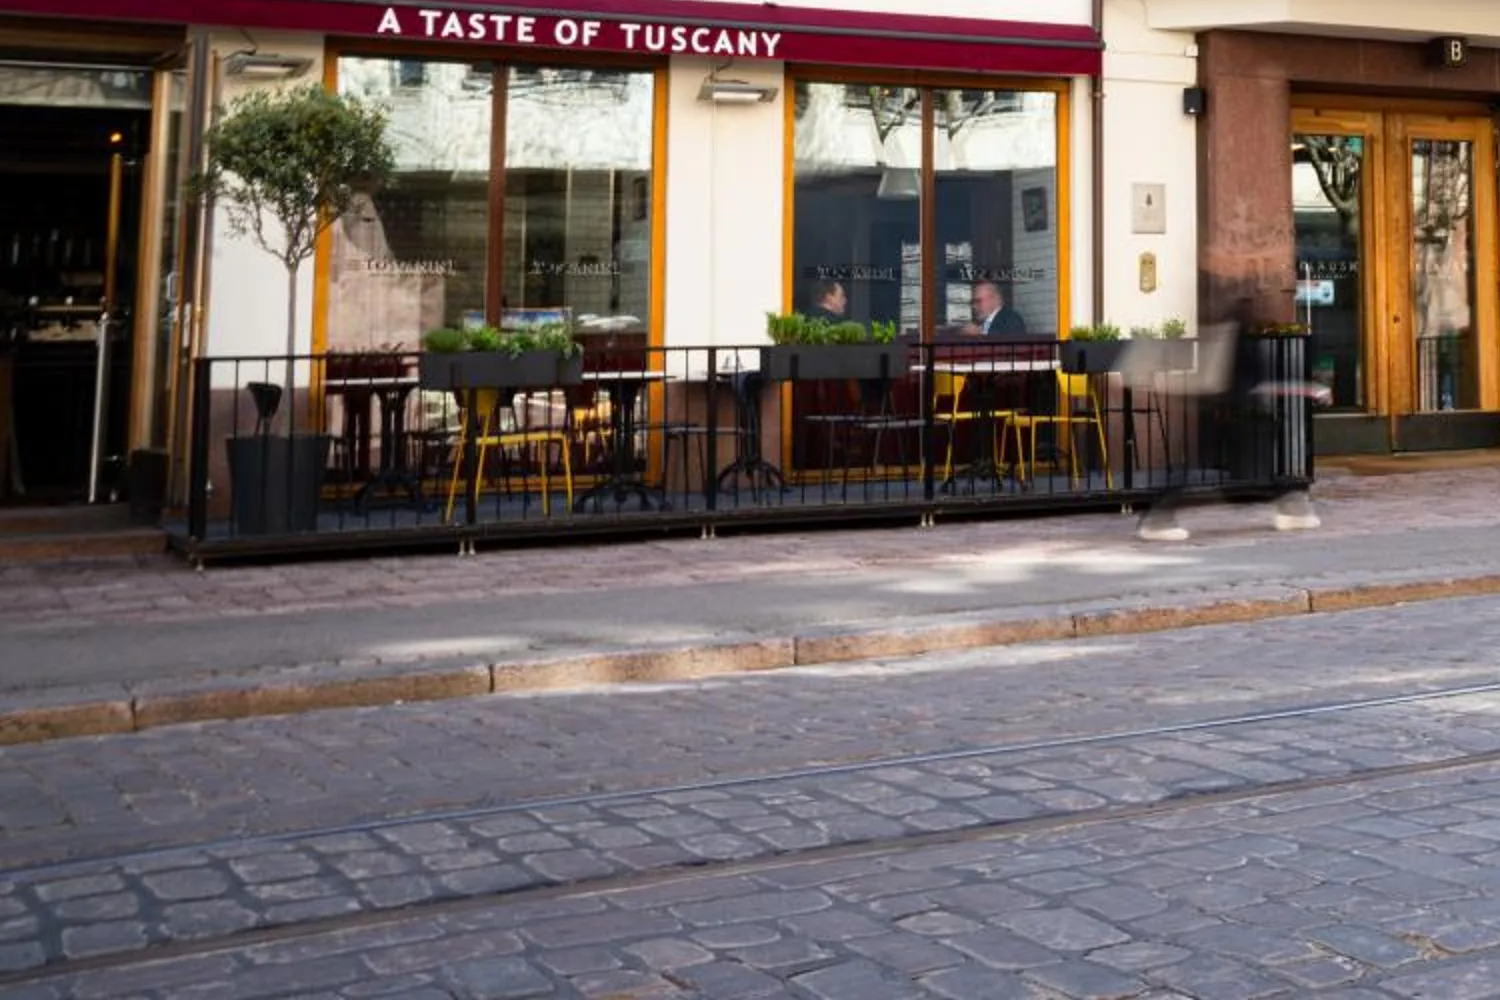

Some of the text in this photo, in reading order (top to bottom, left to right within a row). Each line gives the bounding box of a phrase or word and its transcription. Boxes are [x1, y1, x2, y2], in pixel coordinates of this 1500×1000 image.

[377, 7, 781, 57] A TASTE OF TUSCANY
